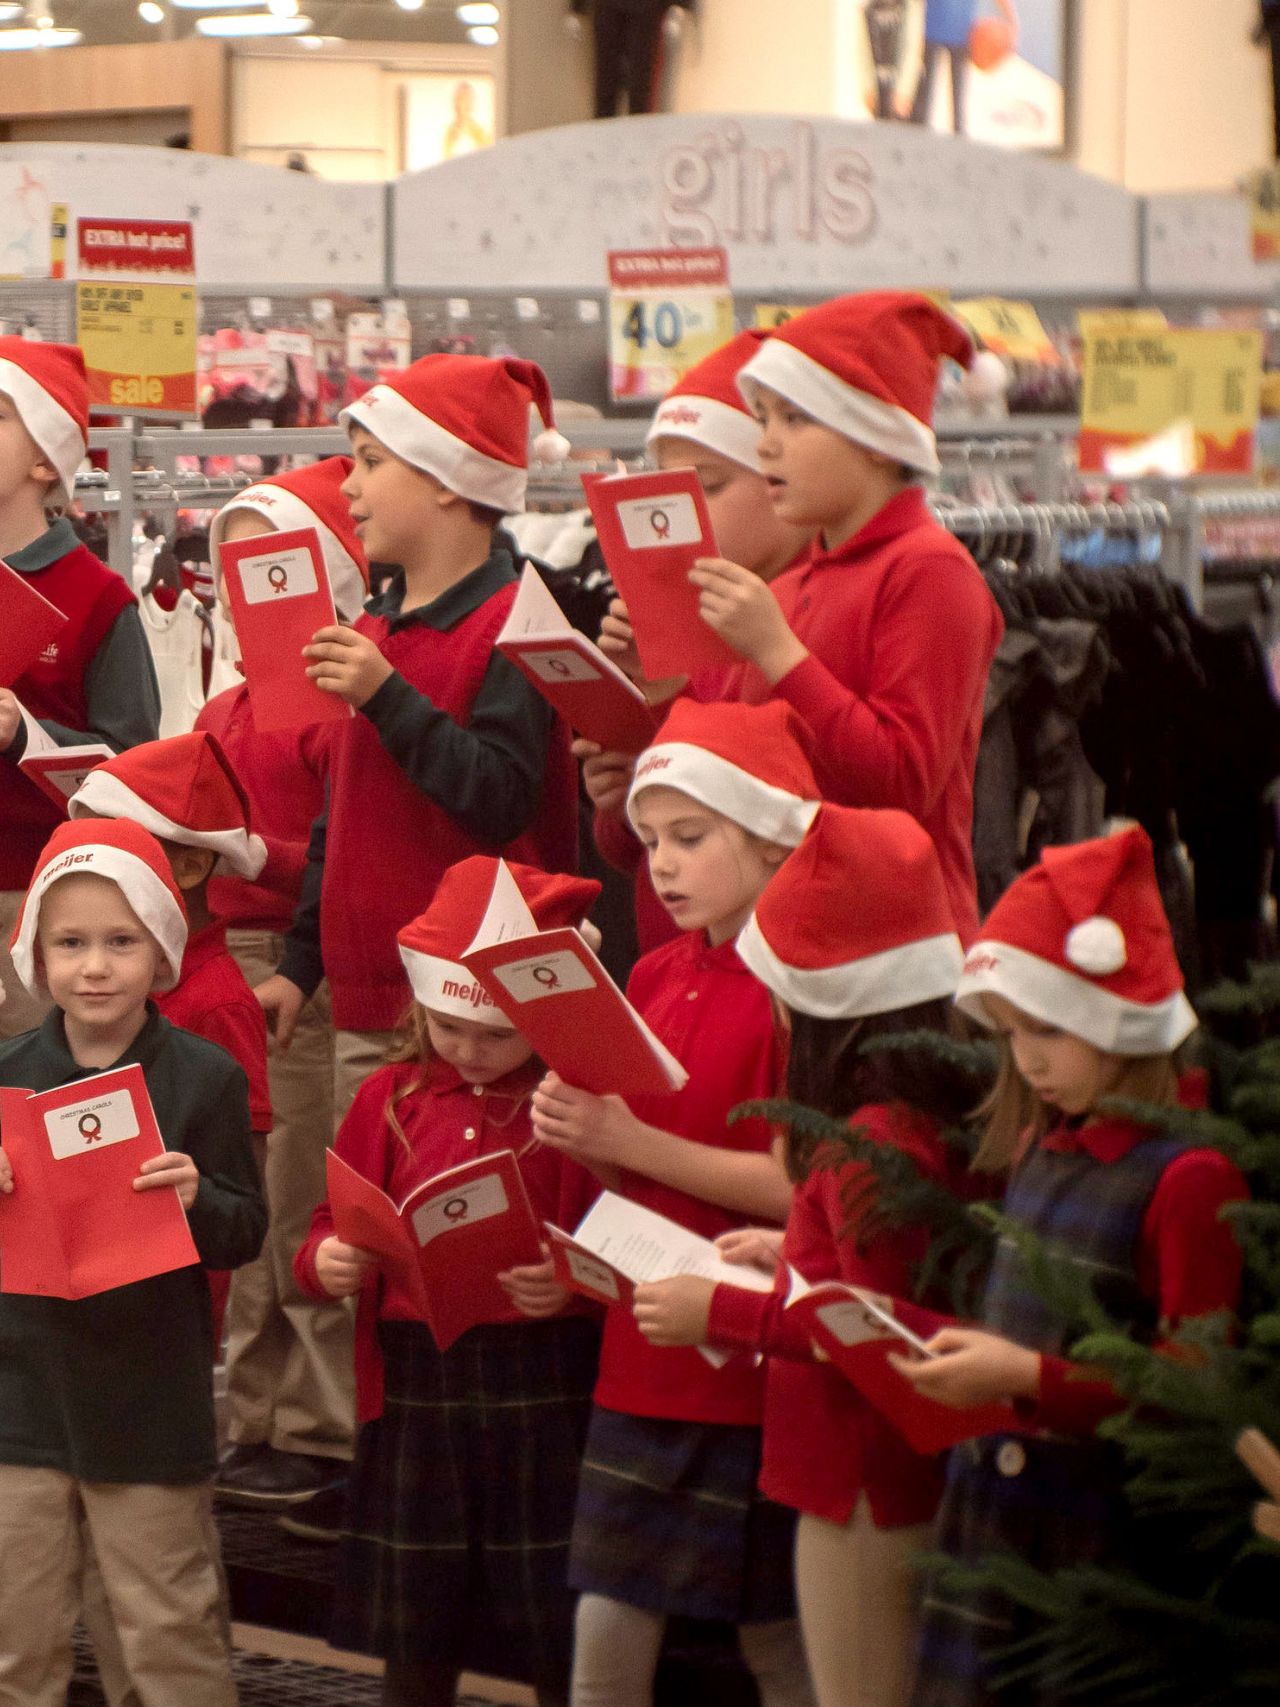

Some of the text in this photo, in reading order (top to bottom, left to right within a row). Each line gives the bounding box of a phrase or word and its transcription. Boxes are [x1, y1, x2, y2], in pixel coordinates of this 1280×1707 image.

[662, 120, 877, 248] girls
[109, 374, 165, 404] sale
[43, 853, 94, 882] meijer
[442, 980, 496, 1008] meije
